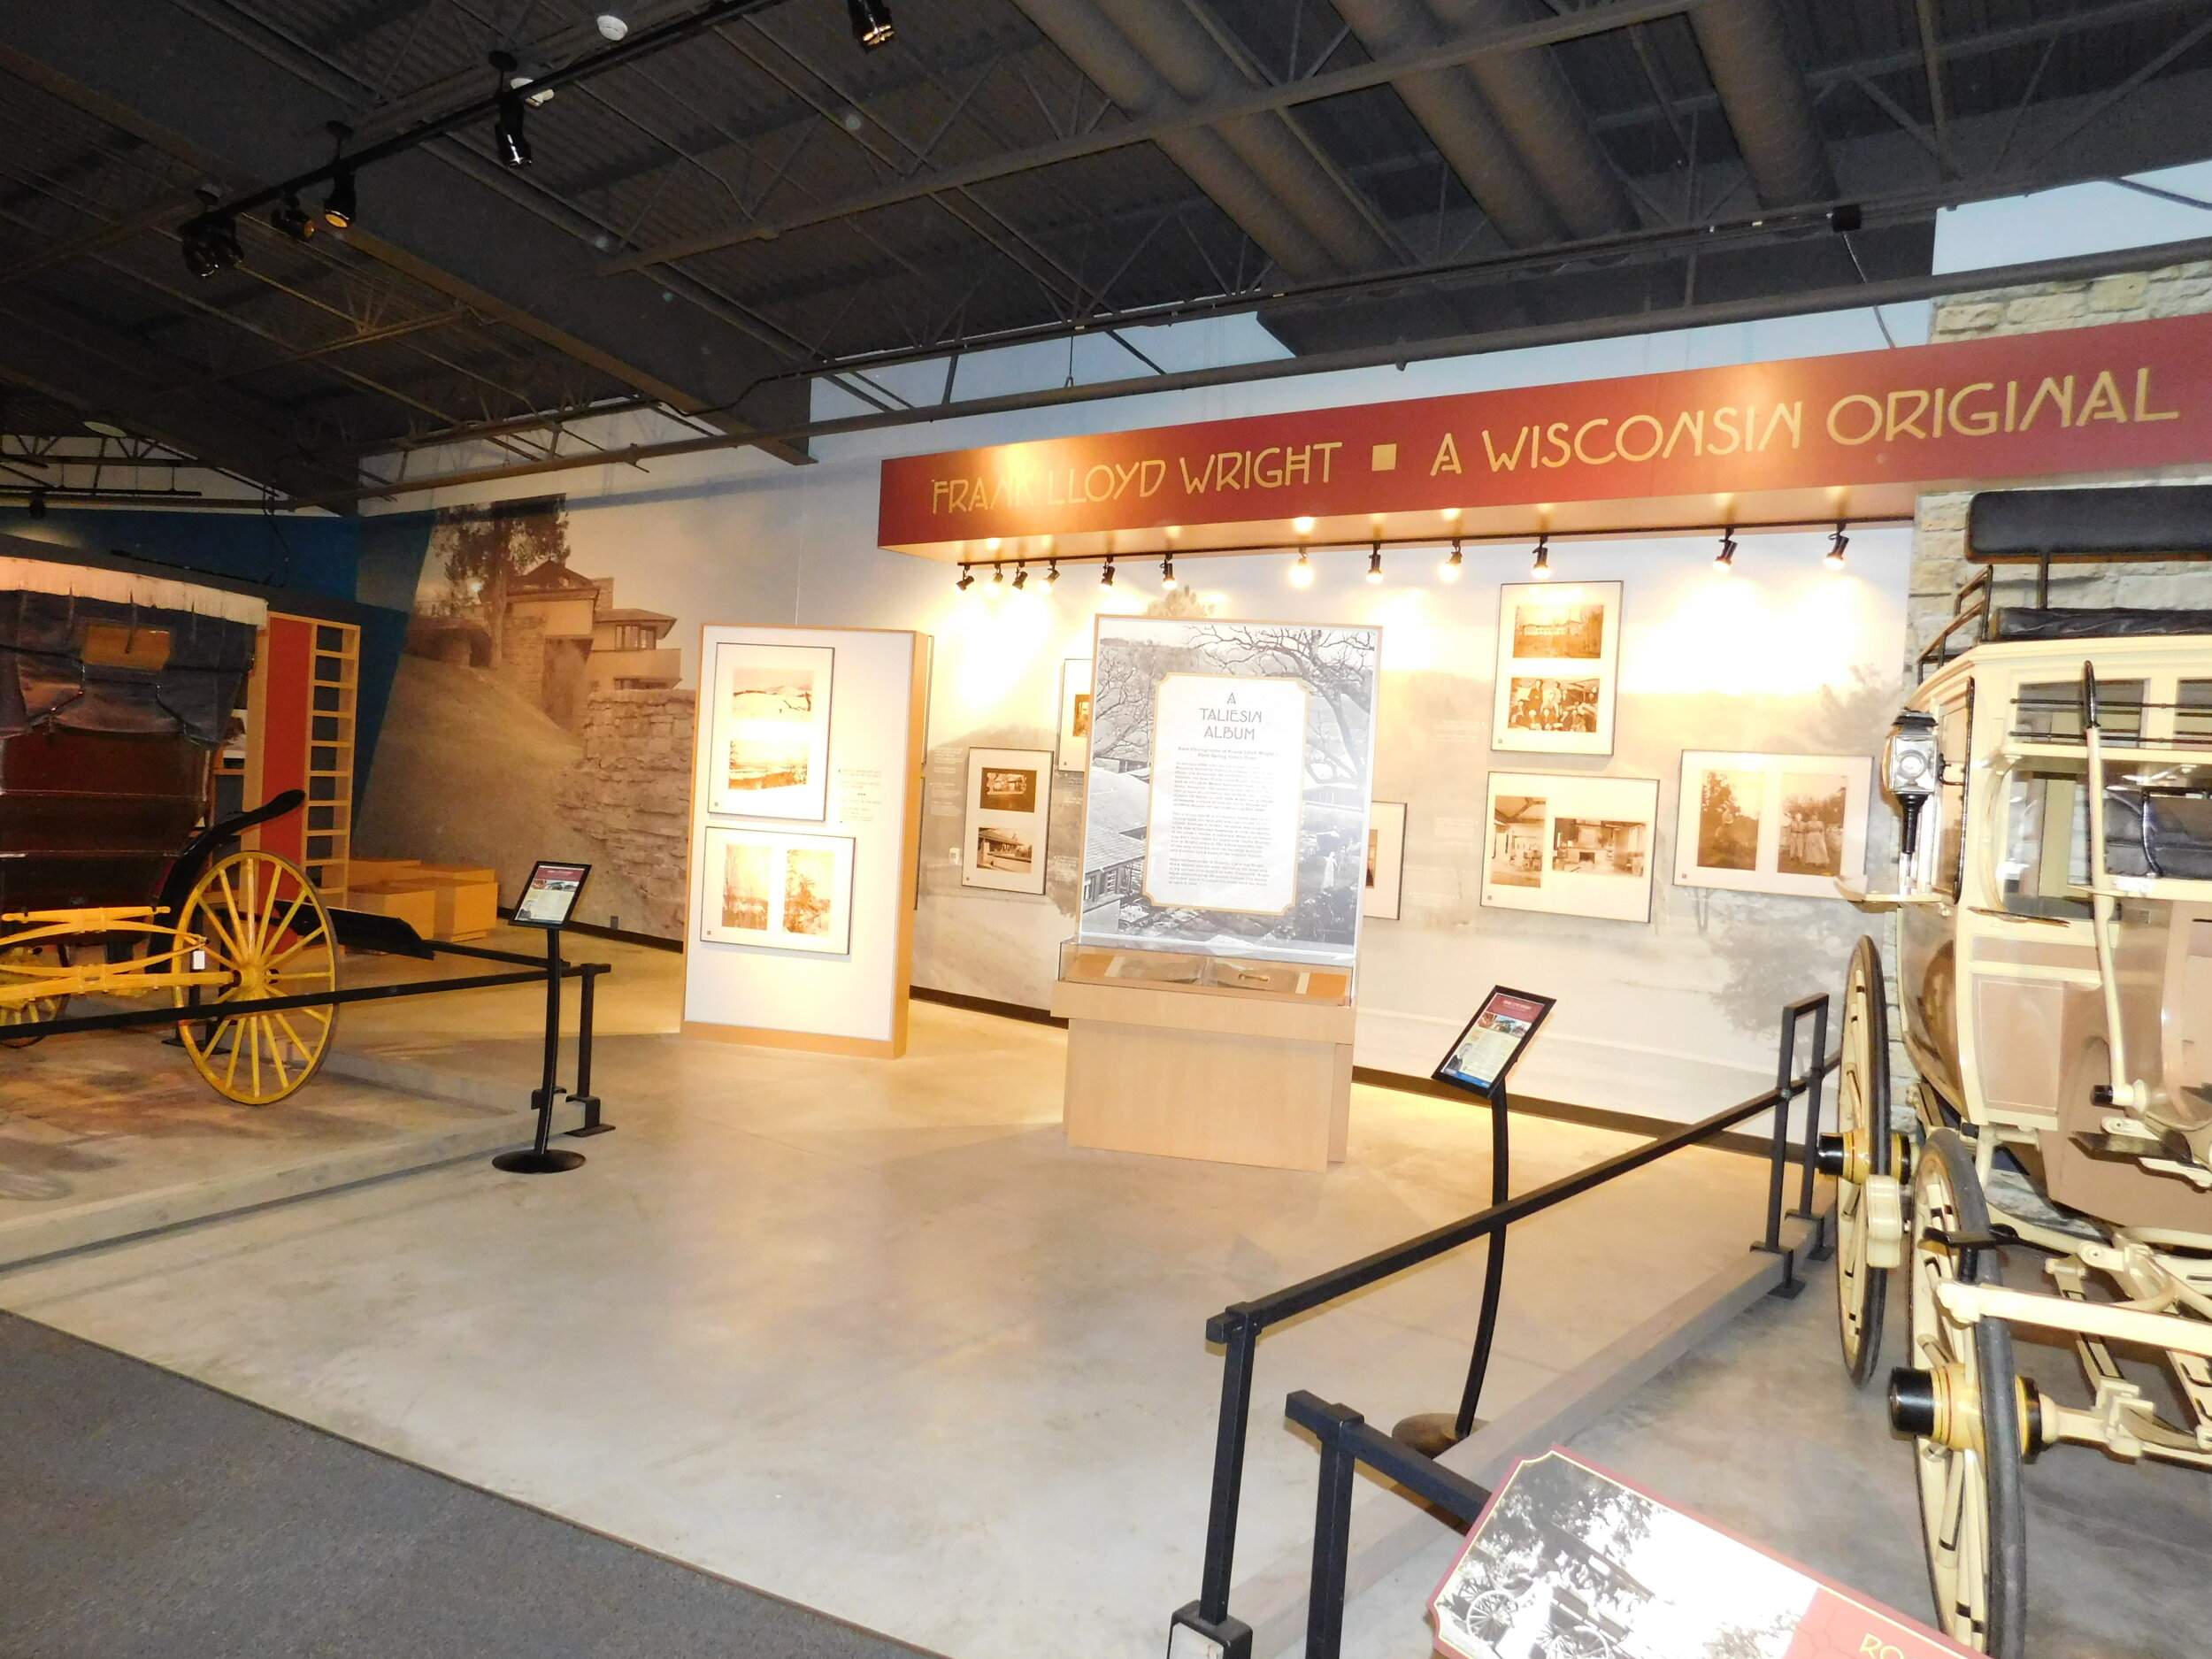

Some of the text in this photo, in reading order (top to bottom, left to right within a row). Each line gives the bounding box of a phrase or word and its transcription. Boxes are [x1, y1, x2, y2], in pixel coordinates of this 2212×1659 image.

[932, 367, 2180, 515] FRANK LLOYD WRIGHT A WISCONSIN ORIGINAL
[1226, 692, 1237, 705] A
[1200, 707, 1263, 724] TALIESIN
[1203, 725, 1256, 741] ALBUM
